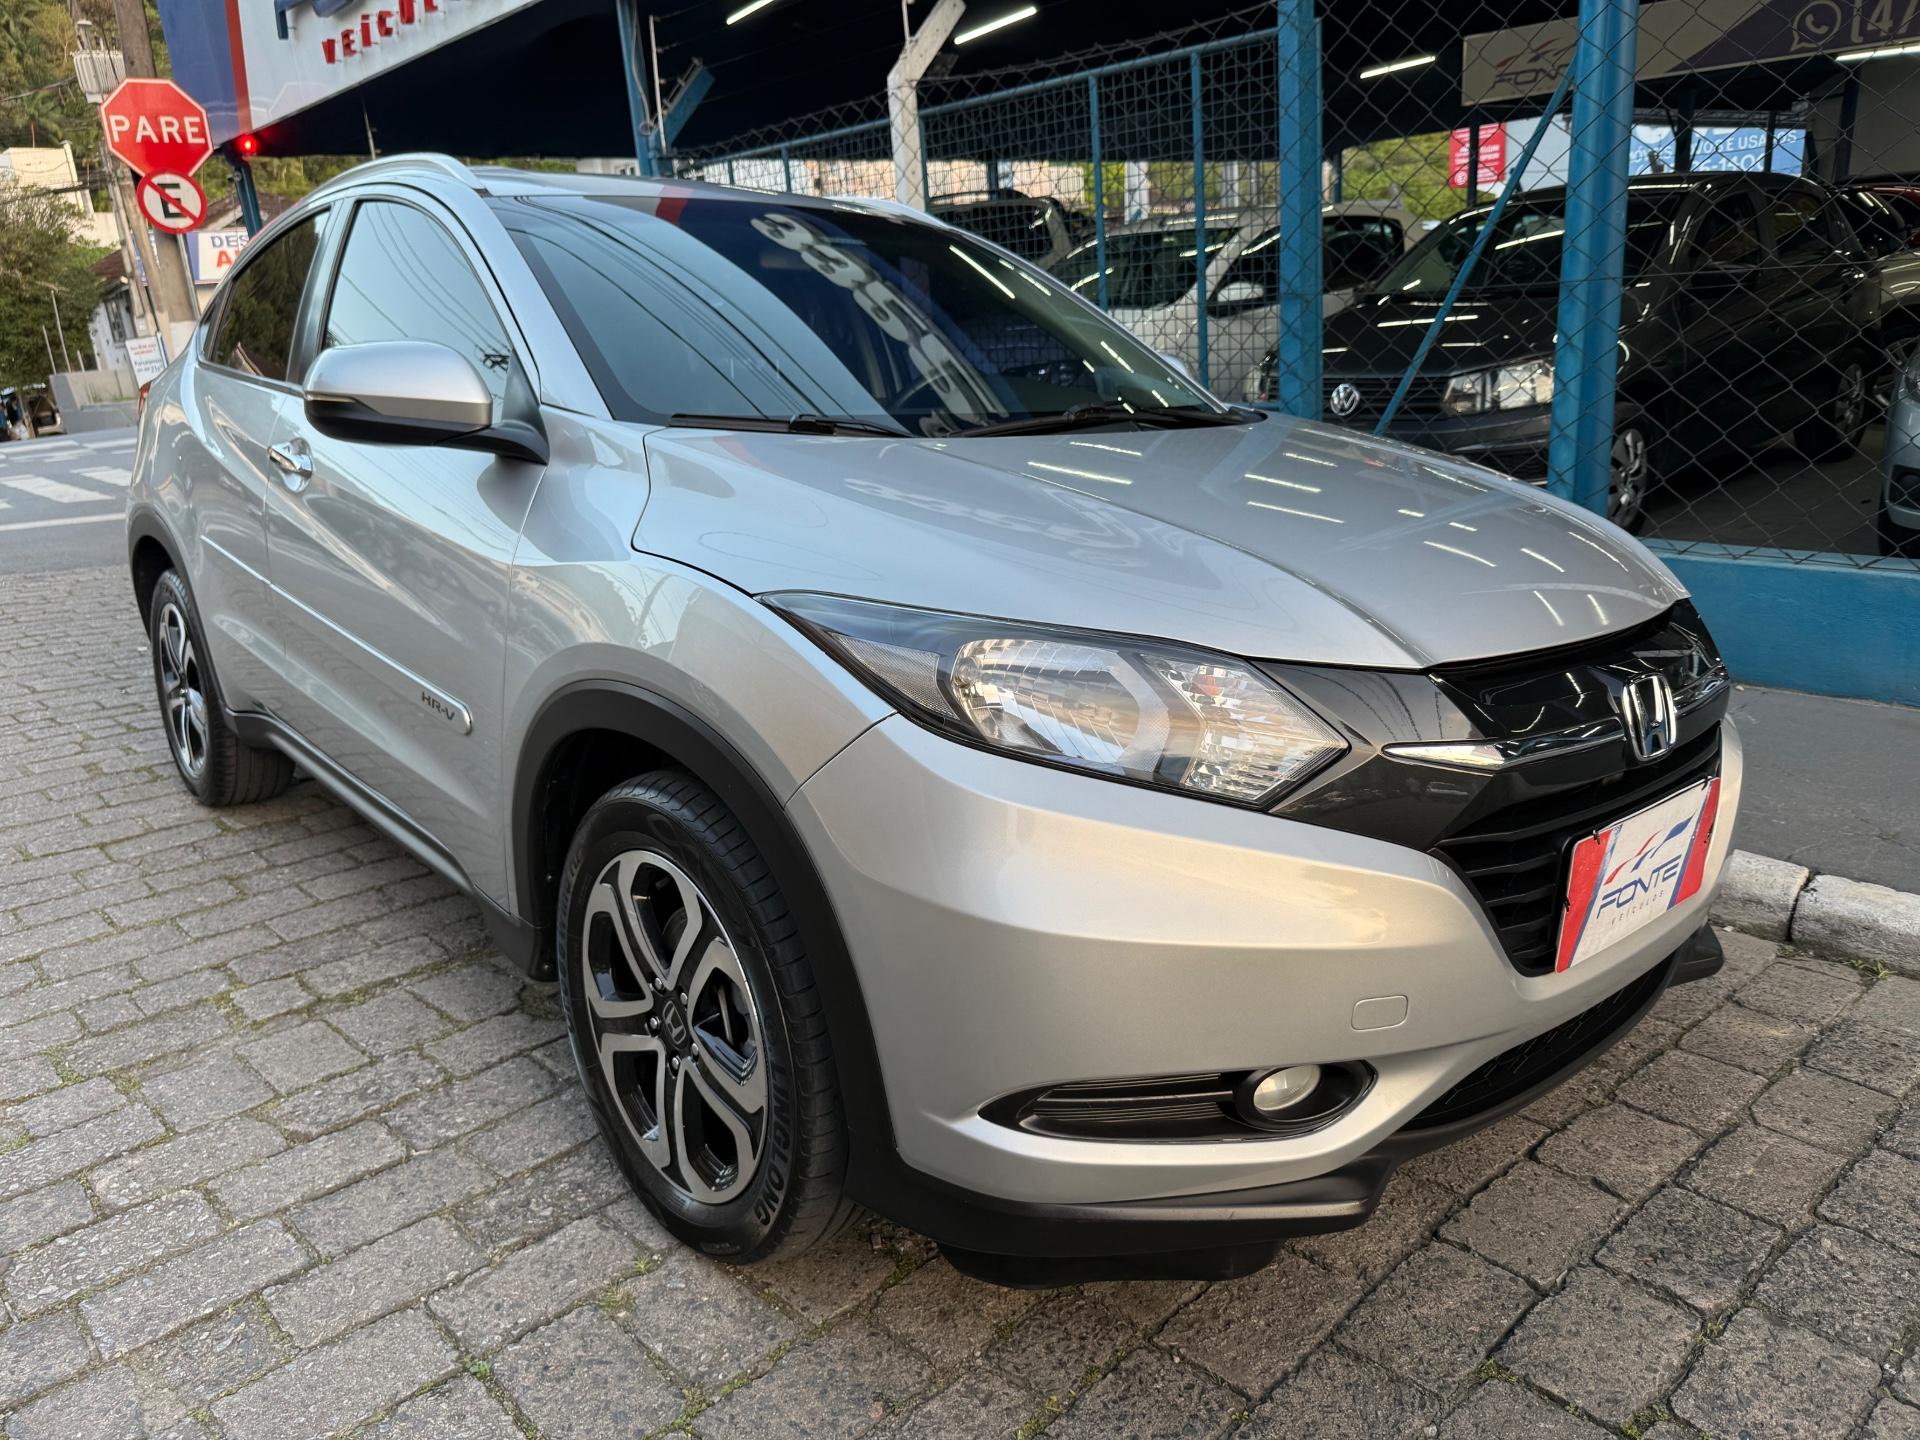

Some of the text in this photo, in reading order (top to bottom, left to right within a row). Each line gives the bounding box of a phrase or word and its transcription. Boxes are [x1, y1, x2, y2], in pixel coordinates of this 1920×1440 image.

[109, 114, 206, 145] PARE
[1738, 129, 1798, 150] USAOS
[156, 182, 188, 219] E
[421, 691, 456, 721] HR-V
[1597, 853, 1682, 920] FONTE
[753, 1062, 791, 1227] LINGLONG
